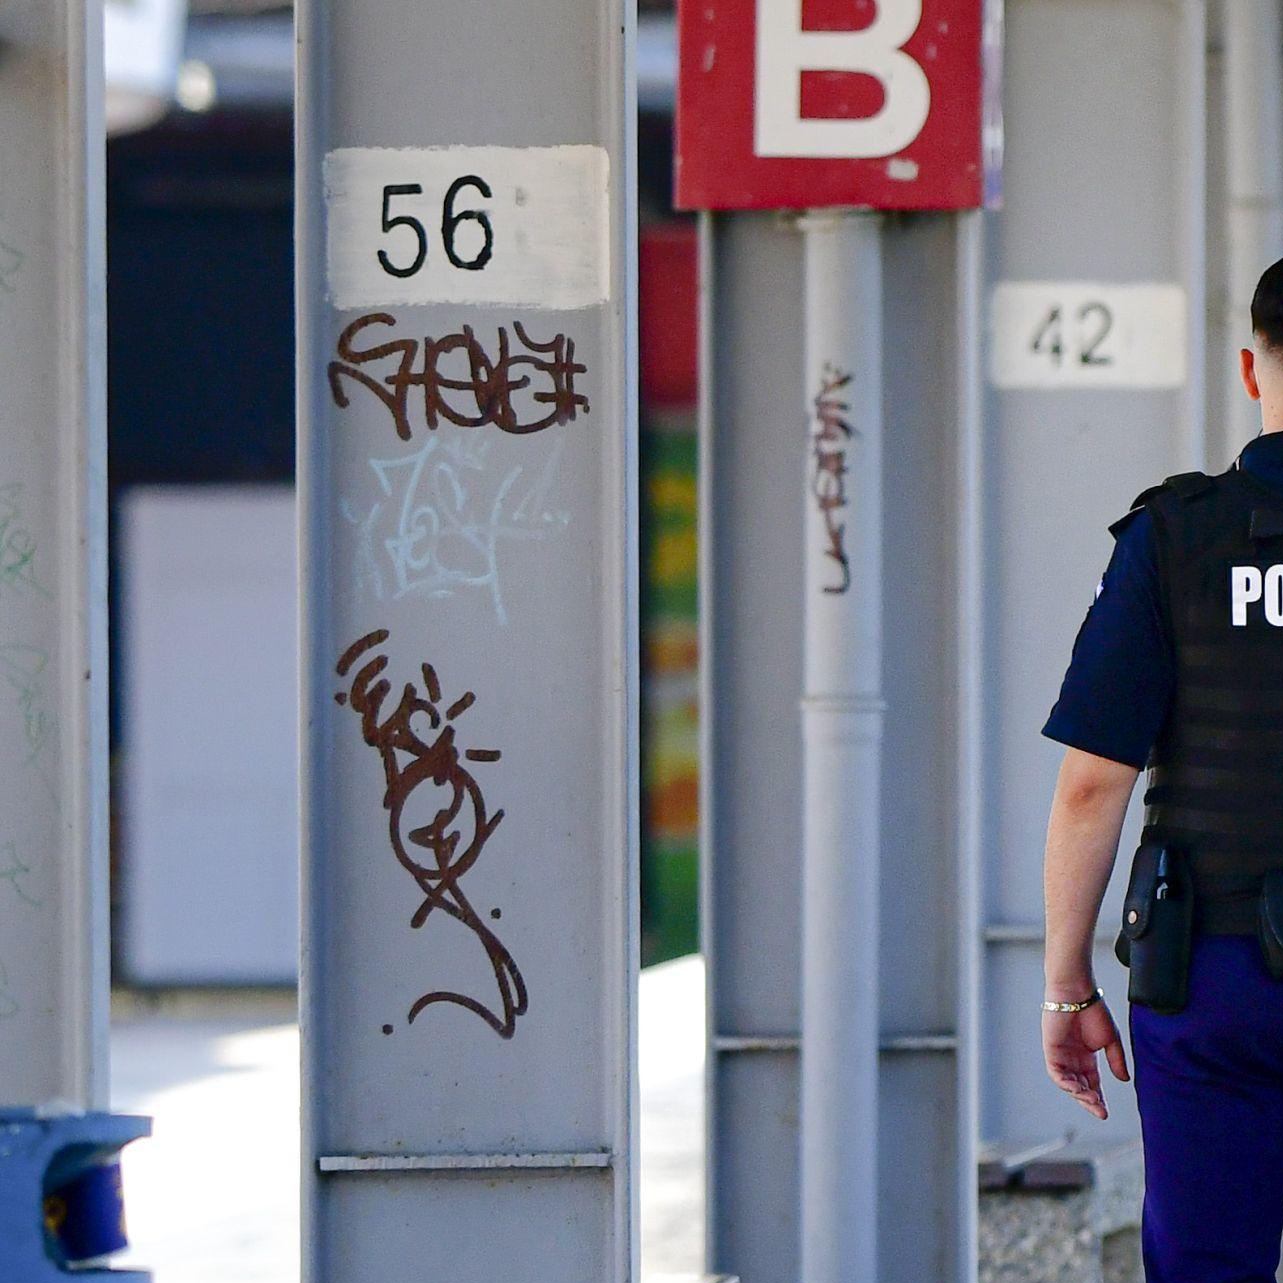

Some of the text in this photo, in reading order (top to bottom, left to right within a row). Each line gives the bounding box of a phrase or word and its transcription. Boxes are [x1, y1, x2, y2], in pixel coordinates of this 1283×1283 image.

[754, 0, 931, 158] B
[377, 175, 495, 279] 56
[1031, 303, 1114, 367] 42
